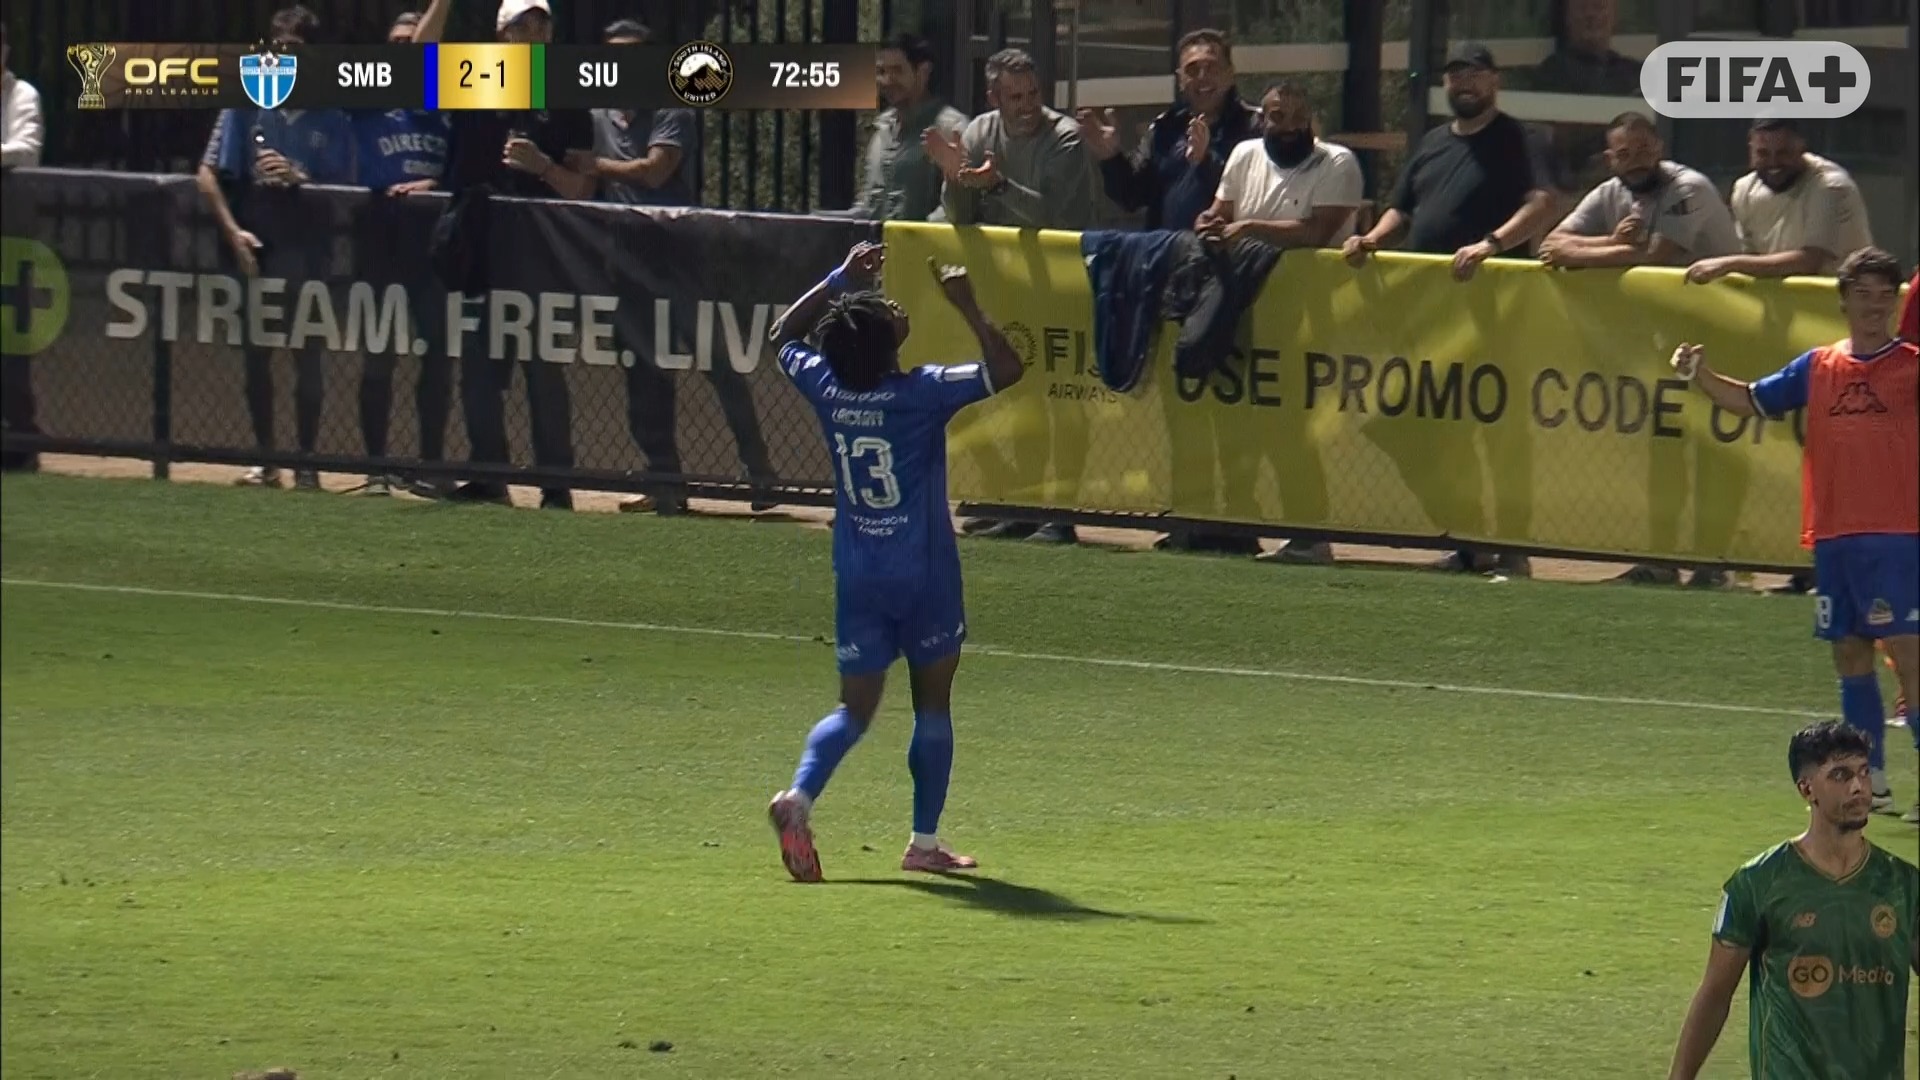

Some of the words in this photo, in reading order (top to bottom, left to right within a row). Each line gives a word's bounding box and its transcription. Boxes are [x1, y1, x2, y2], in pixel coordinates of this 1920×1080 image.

[105, 268, 428, 356] STREAM.
[446, 289, 636, 368] FREE.
[654, 298, 790, 374] LIV
[1304, 351, 1508, 423] PROMO
[1531, 367, 1690, 438] CODE
[834, 432, 901, 510] 13
[1793, 964, 1829, 984] GO
[1838, 964, 1895, 985] Media
